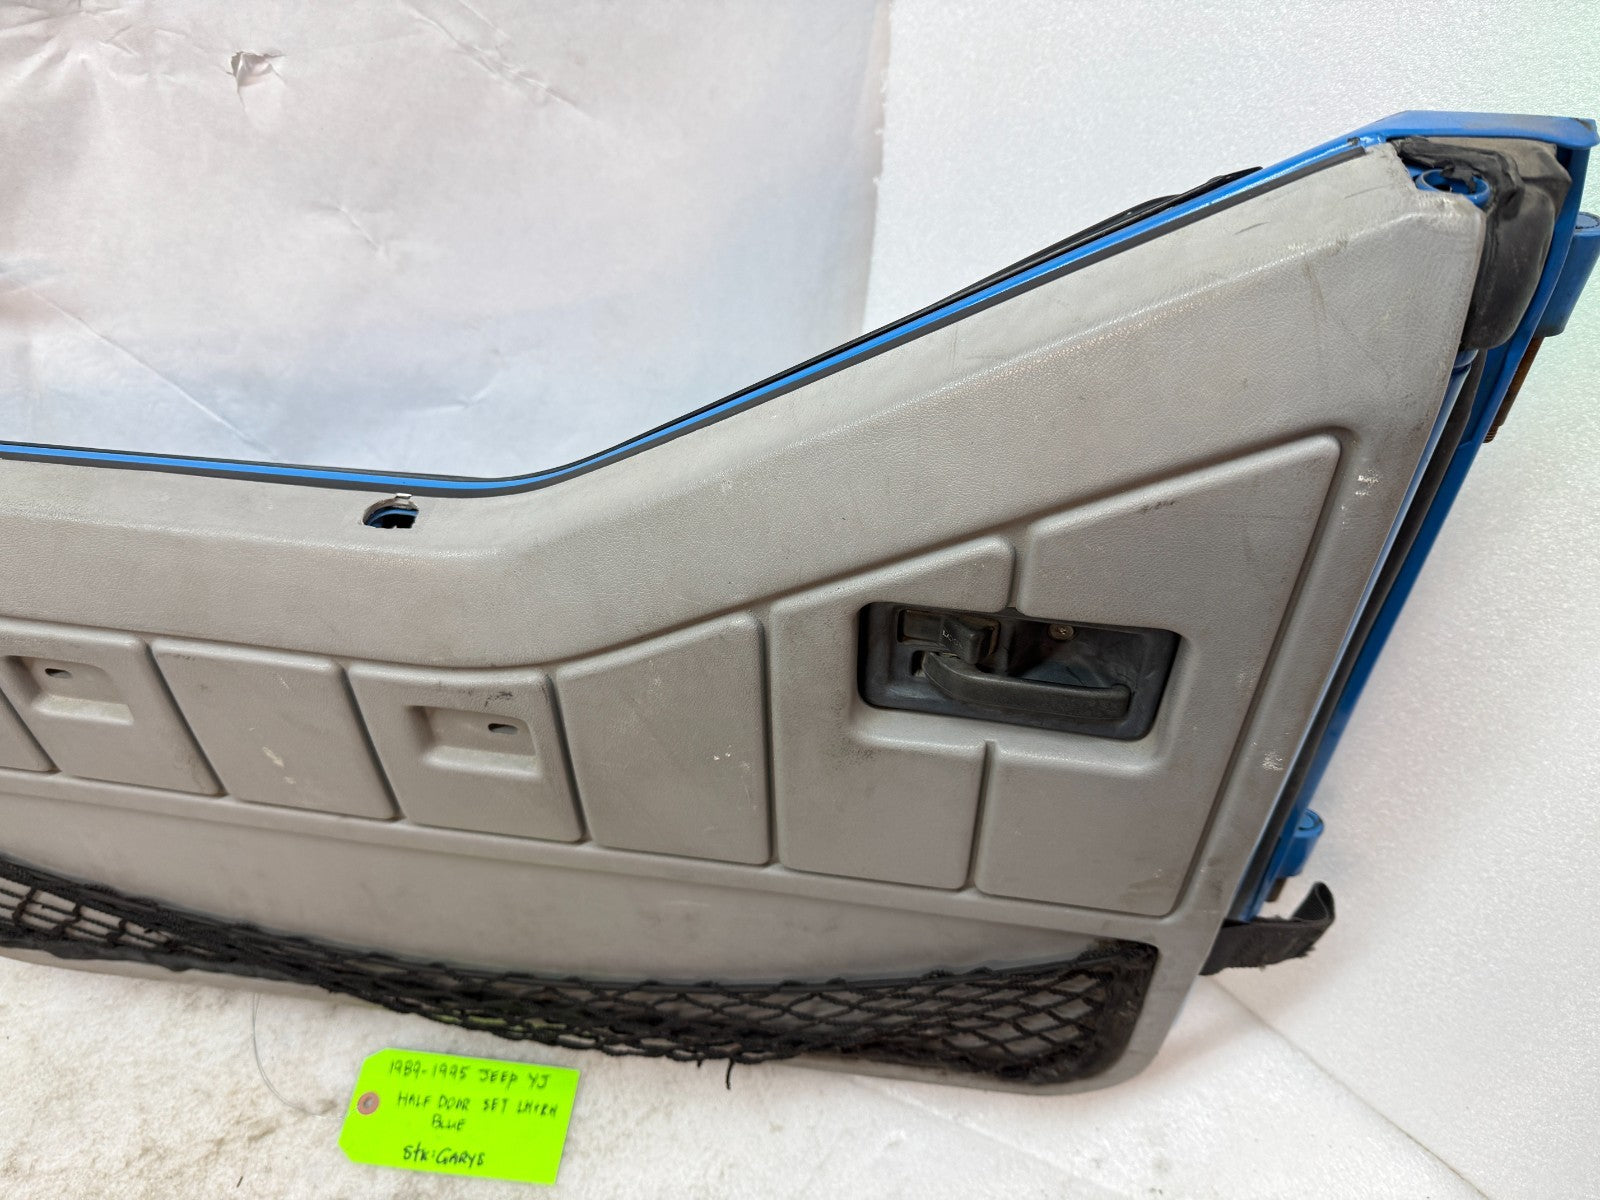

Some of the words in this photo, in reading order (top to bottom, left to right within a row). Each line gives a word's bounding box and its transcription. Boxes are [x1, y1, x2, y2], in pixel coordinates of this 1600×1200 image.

[389, 1059, 469, 1081] 1989-1995
[480, 1067, 518, 1090] JEEP
[528, 1073, 550, 1089] YJ
[398, 1092, 432, 1107] HALF
[438, 1094, 471, 1111] DOOR
[483, 1097, 508, 1113] SET
[432, 1113, 465, 1131] BLUE
